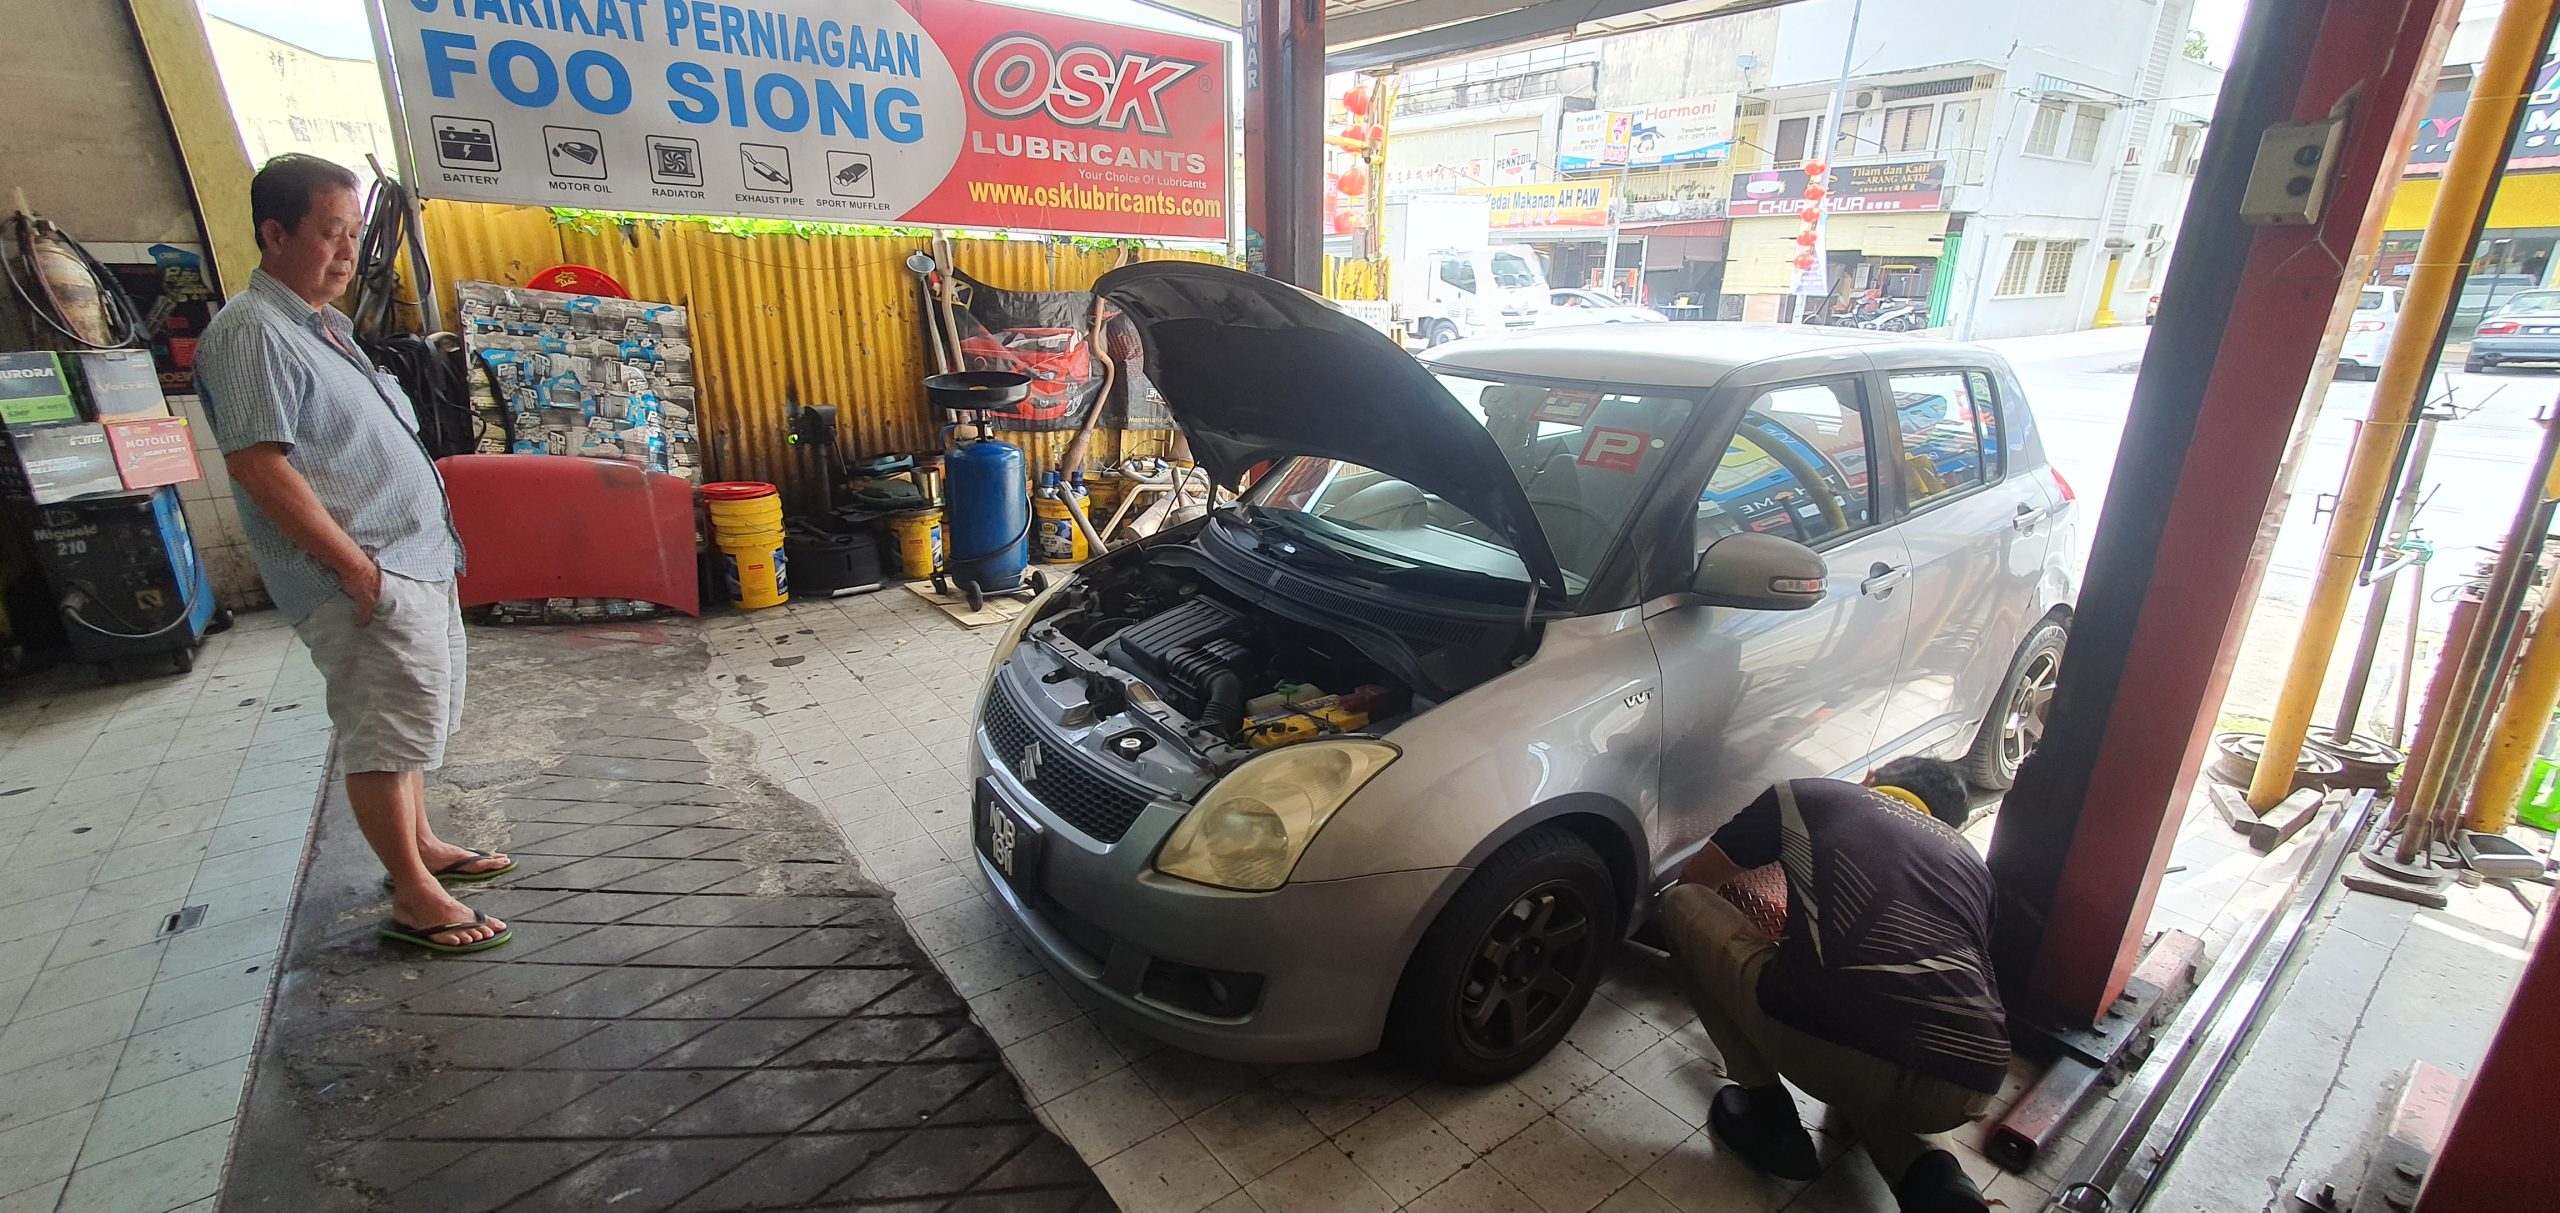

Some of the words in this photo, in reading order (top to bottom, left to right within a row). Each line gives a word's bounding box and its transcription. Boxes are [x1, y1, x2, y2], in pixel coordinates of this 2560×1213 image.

[409, 0, 648, 42] RIKAT
[665, 0, 921, 79] PERNIAGAAN
[420, 28, 633, 116] FOO
[665, 60, 925, 144] SIONG
[970, 33, 1205, 137] OSK
[1645, 99, 1717, 121] Harmoni
[971, 130, 1207, 175] LUBRICANTS
[1496, 152, 1532, 171] PENNZOIL
[443, 173, 500, 186] BATTERY
[1078, 168, 1104, 181] Your
[1105, 170, 1140, 184] Choice
[1142, 174, 1156, 185] Of
[1157, 176, 1208, 190] Lubricants
[1852, 167, 1883, 178] Tilam
[1884, 165, 1903, 176] dan
[1866, 174, 1898, 185] ARANG
[1901, 173, 1930, 183] AKTIF
[548, 181, 591, 194] MOTOR
[593, 184, 612, 194] OIL
[651, 188, 706, 200] RADIATOR
[735, 193, 780, 206] EXHAUST
[782, 196, 806, 206] PIPE
[815, 198, 847, 210] SPORT
[848, 200, 891, 212] MUFFLER
[968, 180, 1222, 219] www.osklubricants.com
[1513, 191, 1555, 209] Makanan
[1558, 189, 1573, 208] AH
[1576, 188, 1600, 207] PAW
[126, 434, 182, 449] MOTOLITE
[1585, 431, 1641, 462] P
[57, 540, 87, 556] 210
[992, 832, 1013, 877] 1811
